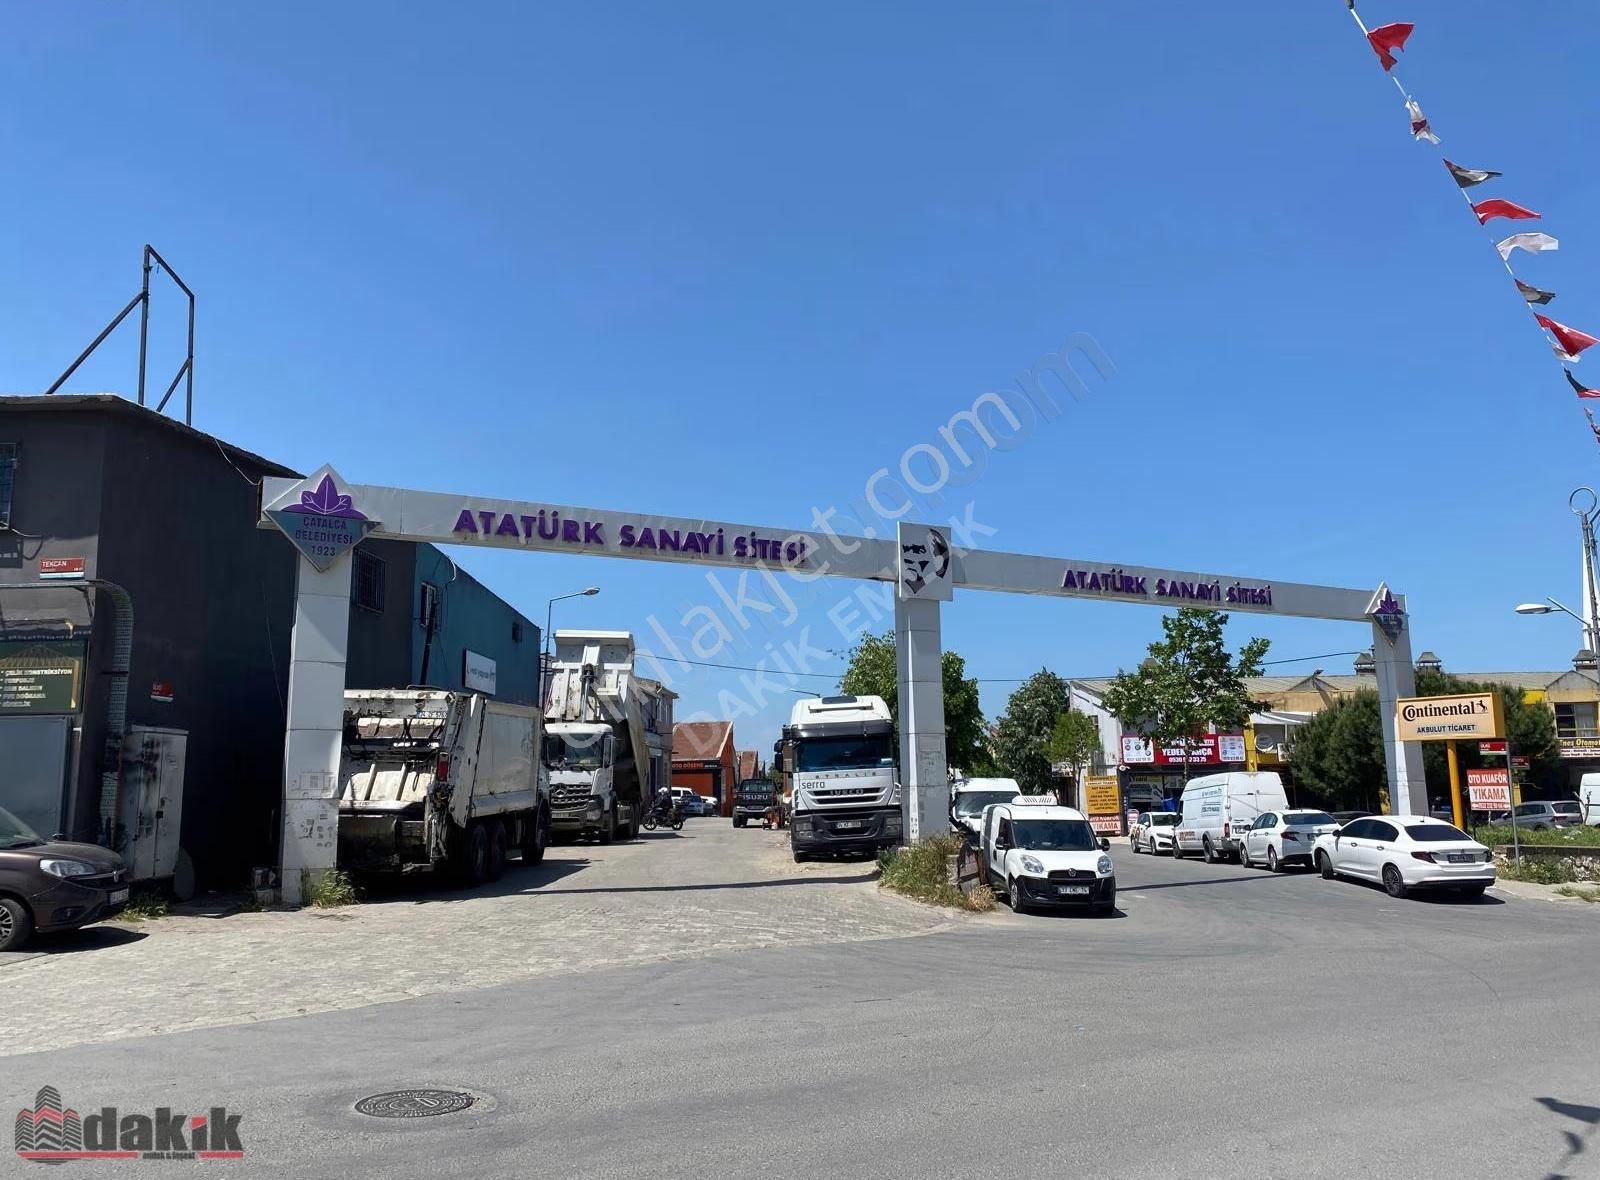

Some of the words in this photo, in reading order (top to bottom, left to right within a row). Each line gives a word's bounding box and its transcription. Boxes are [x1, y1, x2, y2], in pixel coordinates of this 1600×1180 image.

[453, 509, 604, 545] ATATÜRK
[619, 524, 724, 555] SANAYİ
[733, 531, 806, 563] SİTESİ
[311, 545, 336, 556] 1923
[1061, 568, 1148, 595] ATATÜRK
[1155, 579, 1221, 600] SANAYİ
[1226, 581, 1273, 606] SİTESİ
[1403, 701, 1475, 721] Continental
[1417, 725, 1446, 733] AKBULUT
[1448, 723, 1475, 732] TİCARET
[1162, 748, 1186, 756] YEDEK
[1189, 748, 1213, 756] ARÇA
[1468, 774, 1480, 783] OTO
[1481, 772, 1508, 784] KUAFÖR
[801, 781, 825, 789] serra
[1472, 788, 1506, 800] YIKAMA
